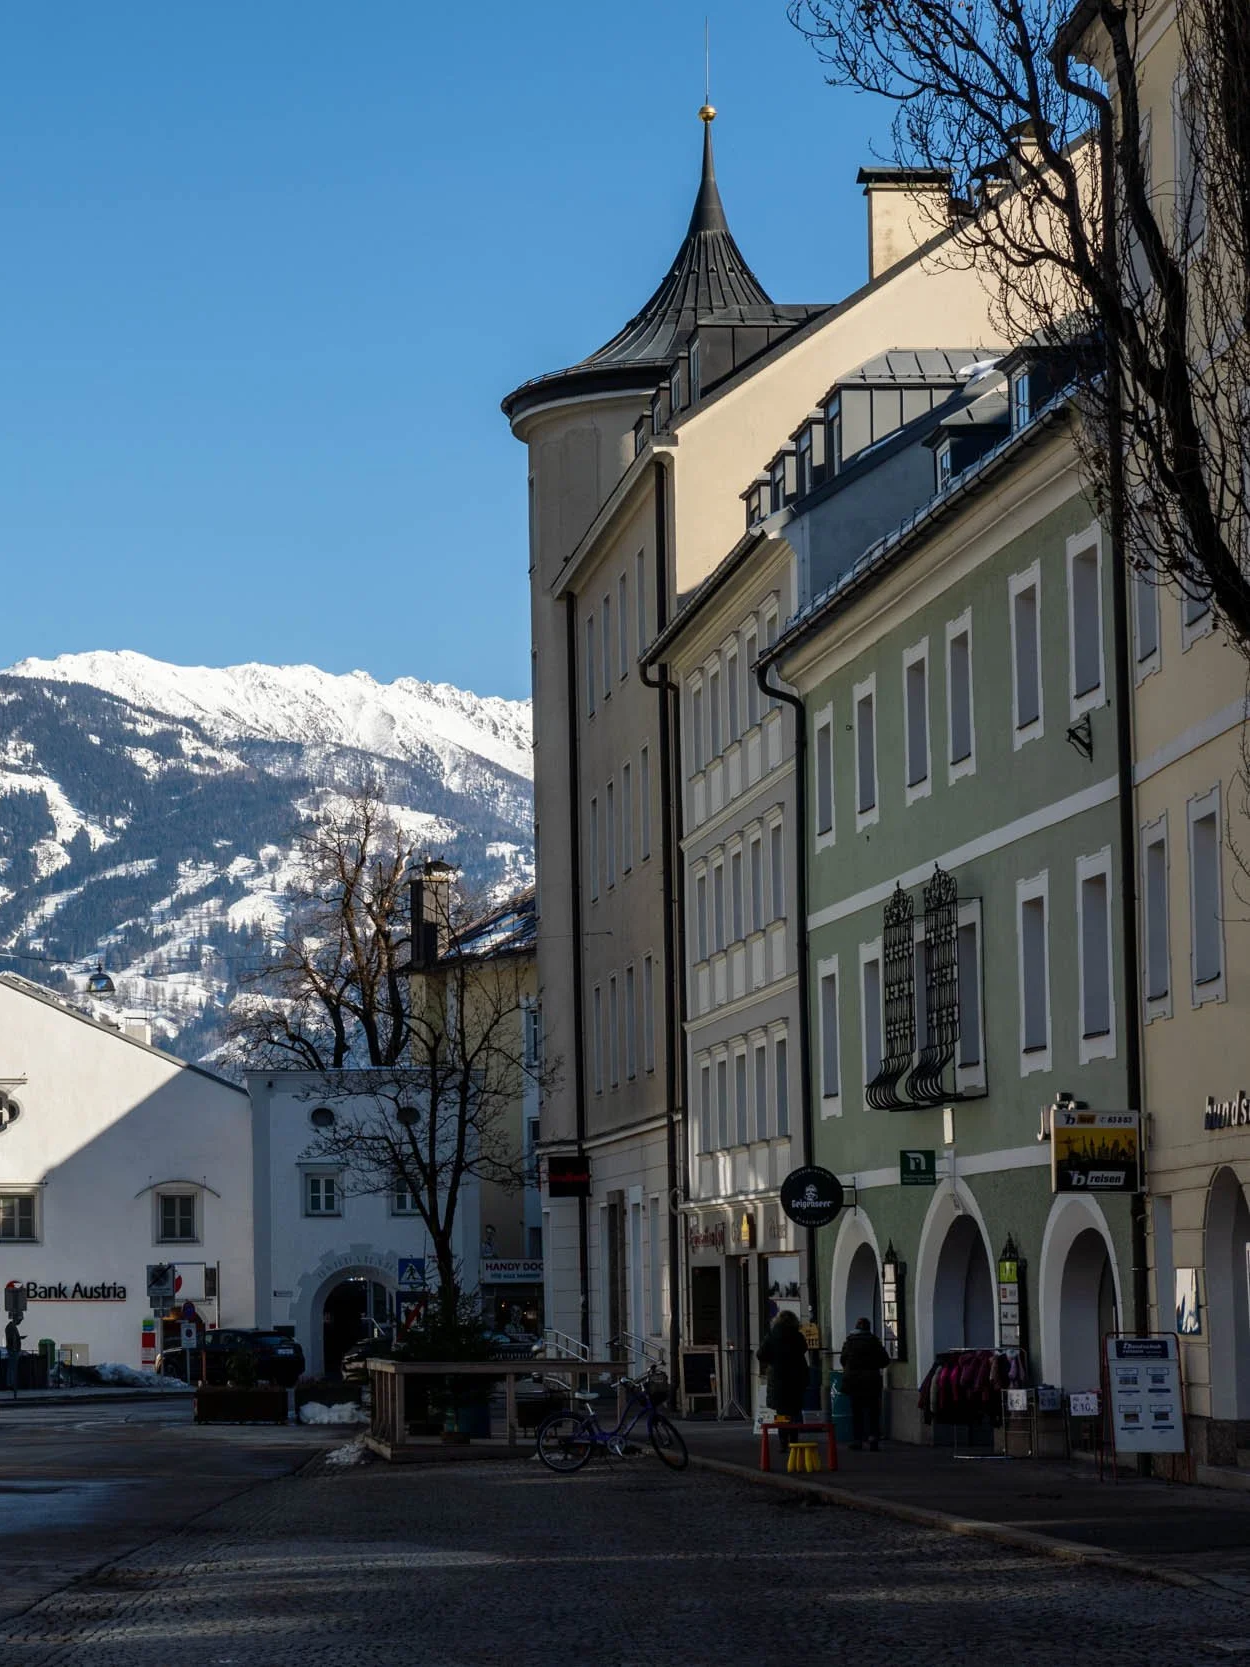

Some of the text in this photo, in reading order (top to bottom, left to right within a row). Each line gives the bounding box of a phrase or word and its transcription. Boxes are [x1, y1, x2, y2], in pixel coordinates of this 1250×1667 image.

[1090, 1174, 1121, 1183] reisen
[485, 1262, 521, 1271] HANDY
[26, 1282, 126, 1299] Bank Austria
